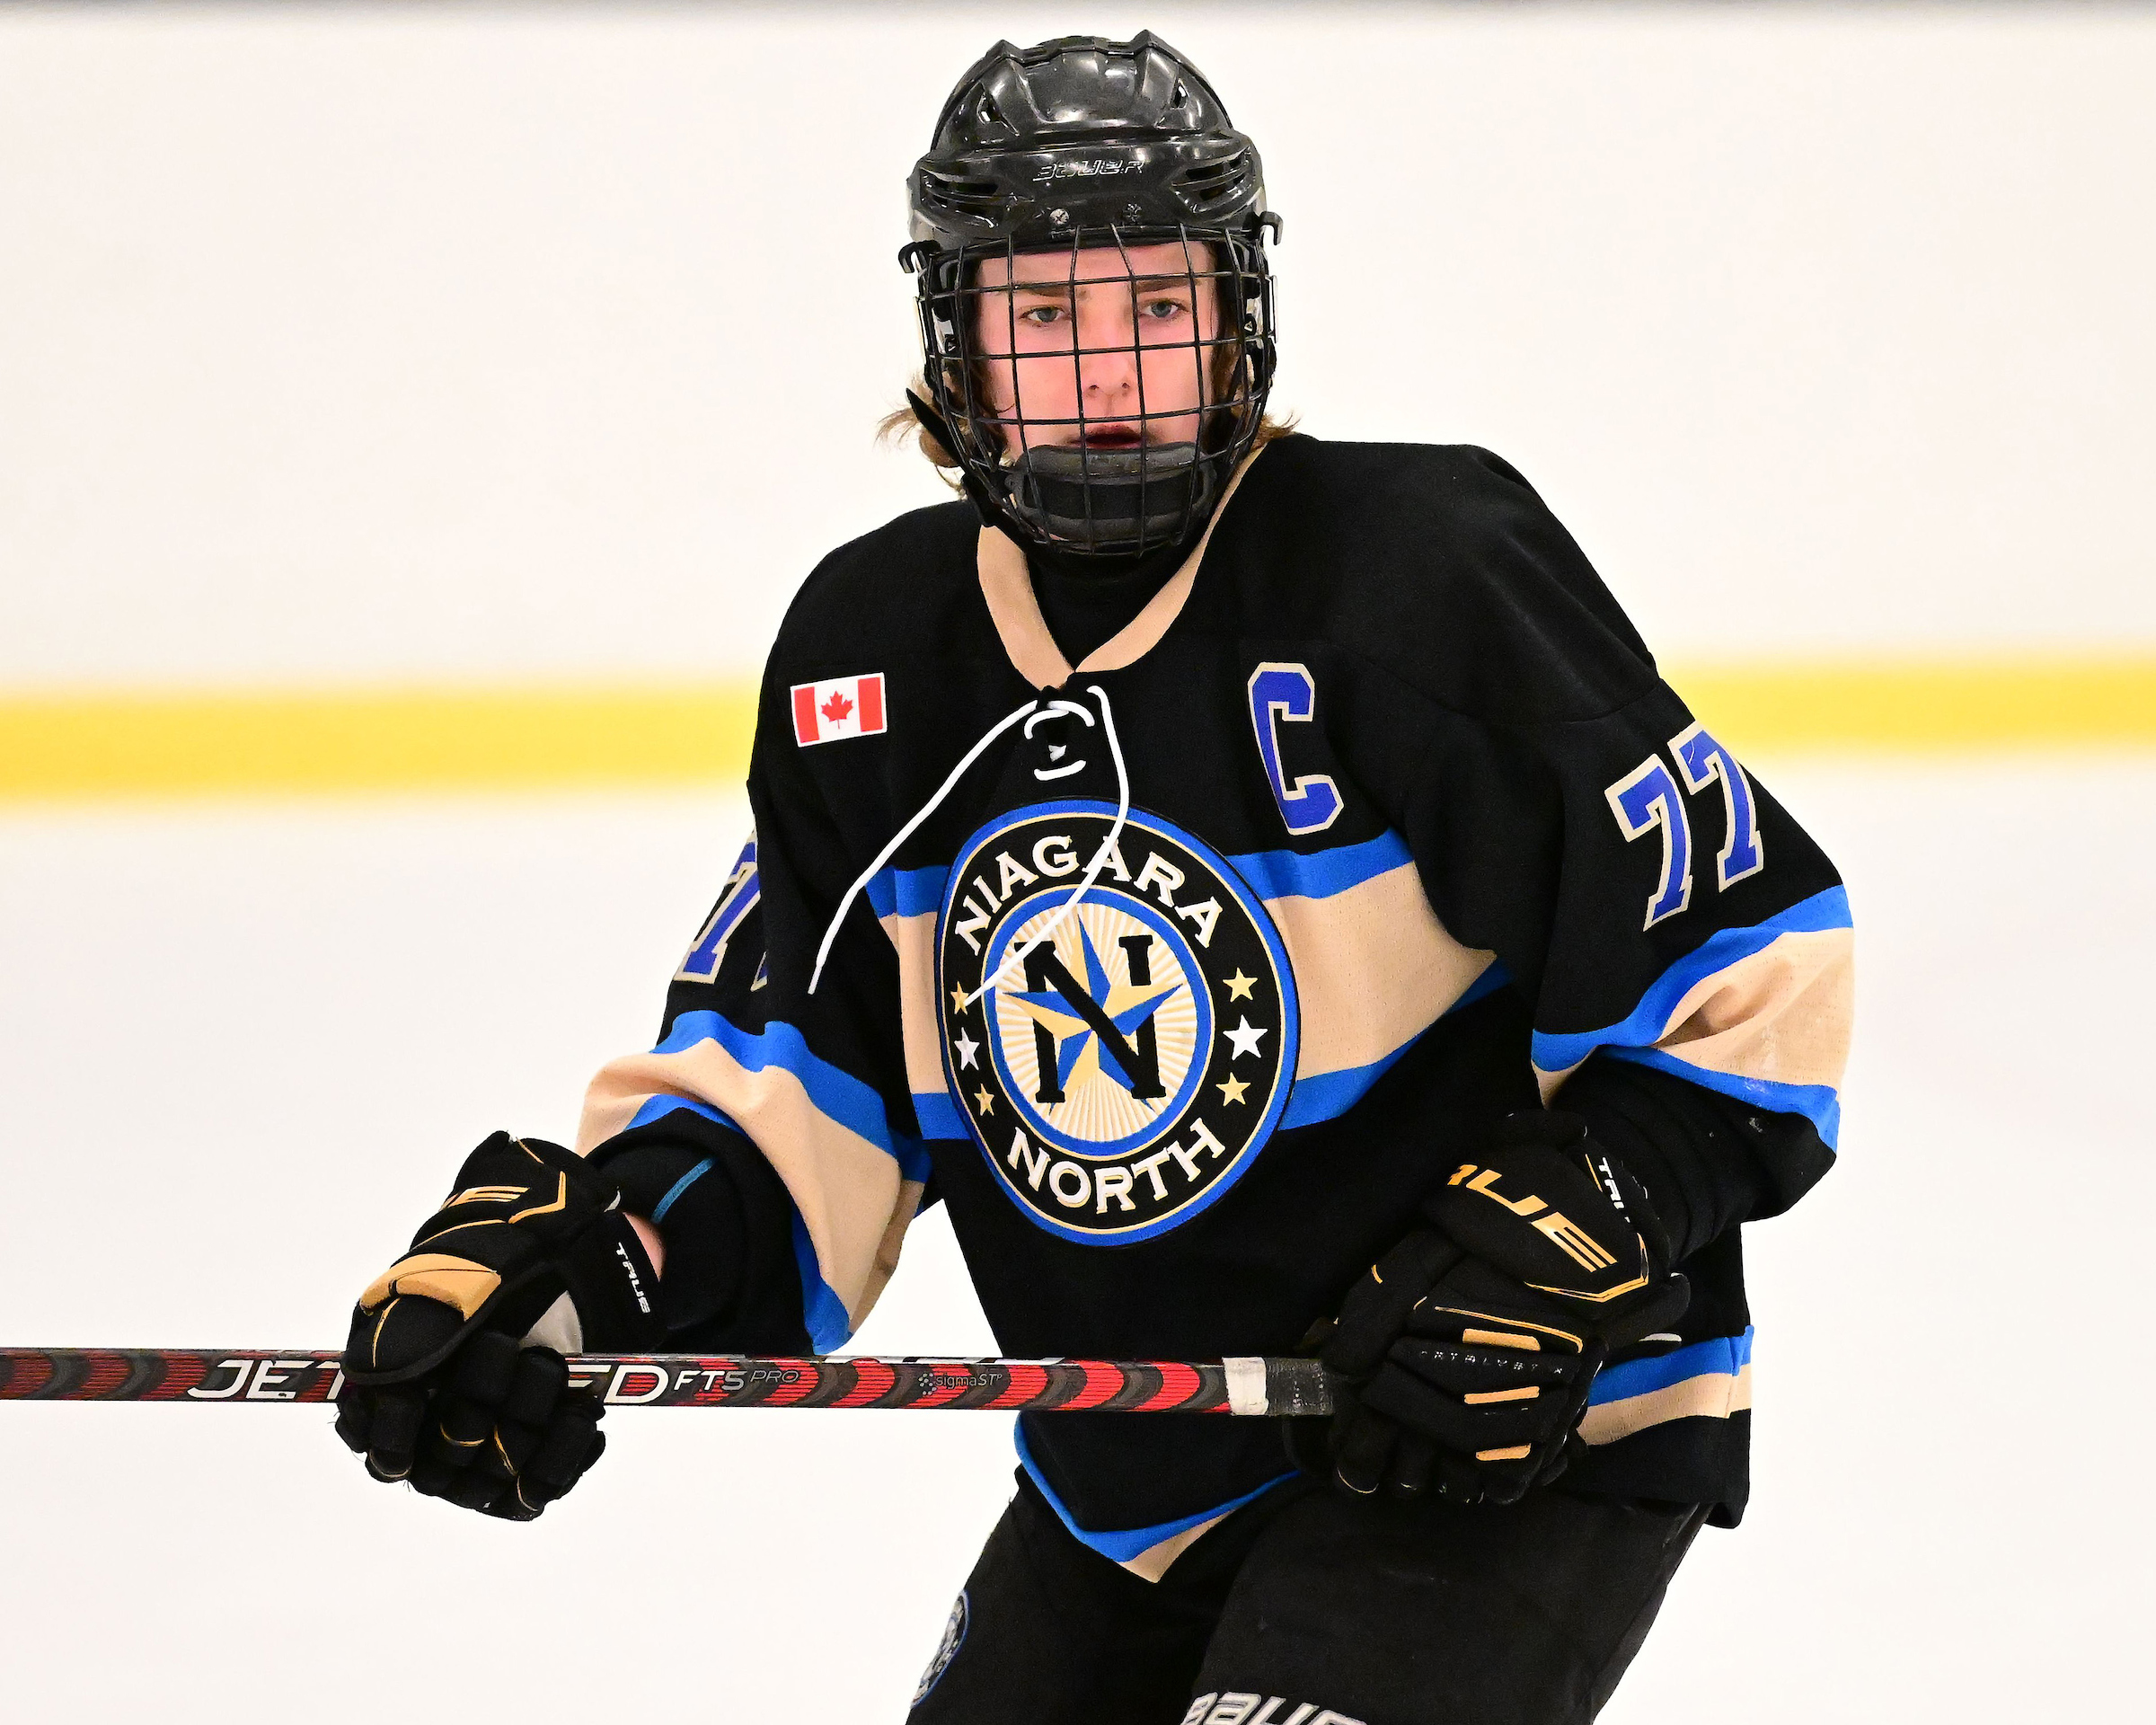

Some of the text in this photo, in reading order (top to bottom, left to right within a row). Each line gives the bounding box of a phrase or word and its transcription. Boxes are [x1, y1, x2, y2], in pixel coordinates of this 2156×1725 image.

[1247, 661, 1344, 836] C
[1604, 721, 1763, 932] 77
[955, 835, 1224, 956] NIAGARA
[1013, 934, 1167, 1103] N
[1007, 1117, 1225, 1215] NORTH
[615, 1242, 651, 1314] TRUE
[674, 1370, 747, 1391] FT5
[749, 1369, 799, 1384] PRO
